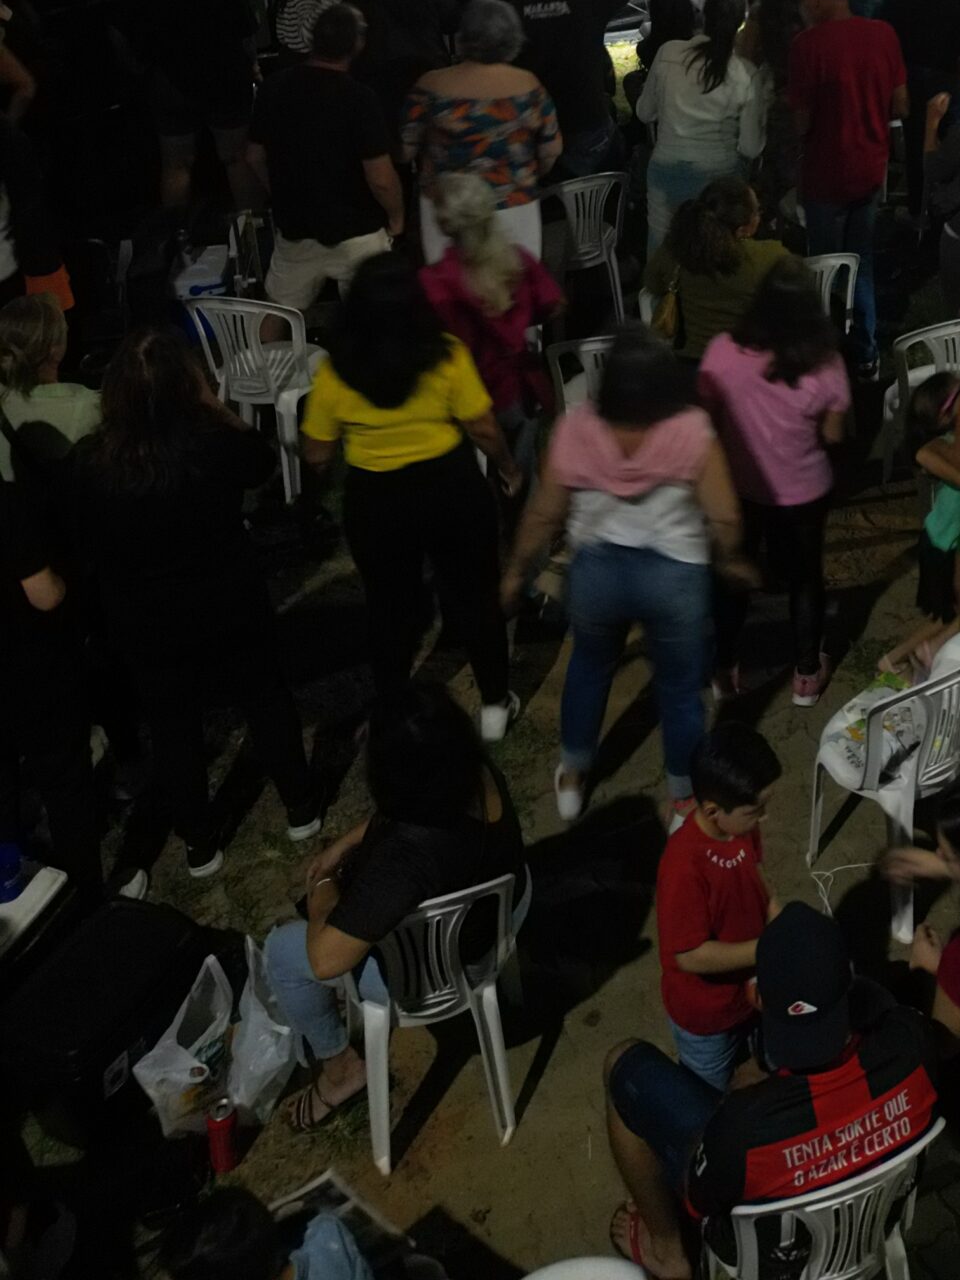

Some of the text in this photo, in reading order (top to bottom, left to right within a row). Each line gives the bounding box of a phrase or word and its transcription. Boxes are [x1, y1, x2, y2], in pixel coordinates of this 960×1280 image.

[782, 1089, 912, 1168] TENTA SORTE QUE
[794, 1170, 805, 1186] O
[808, 1149, 848, 1182] AZAR
[864, 1116, 912, 1156] CERTO
